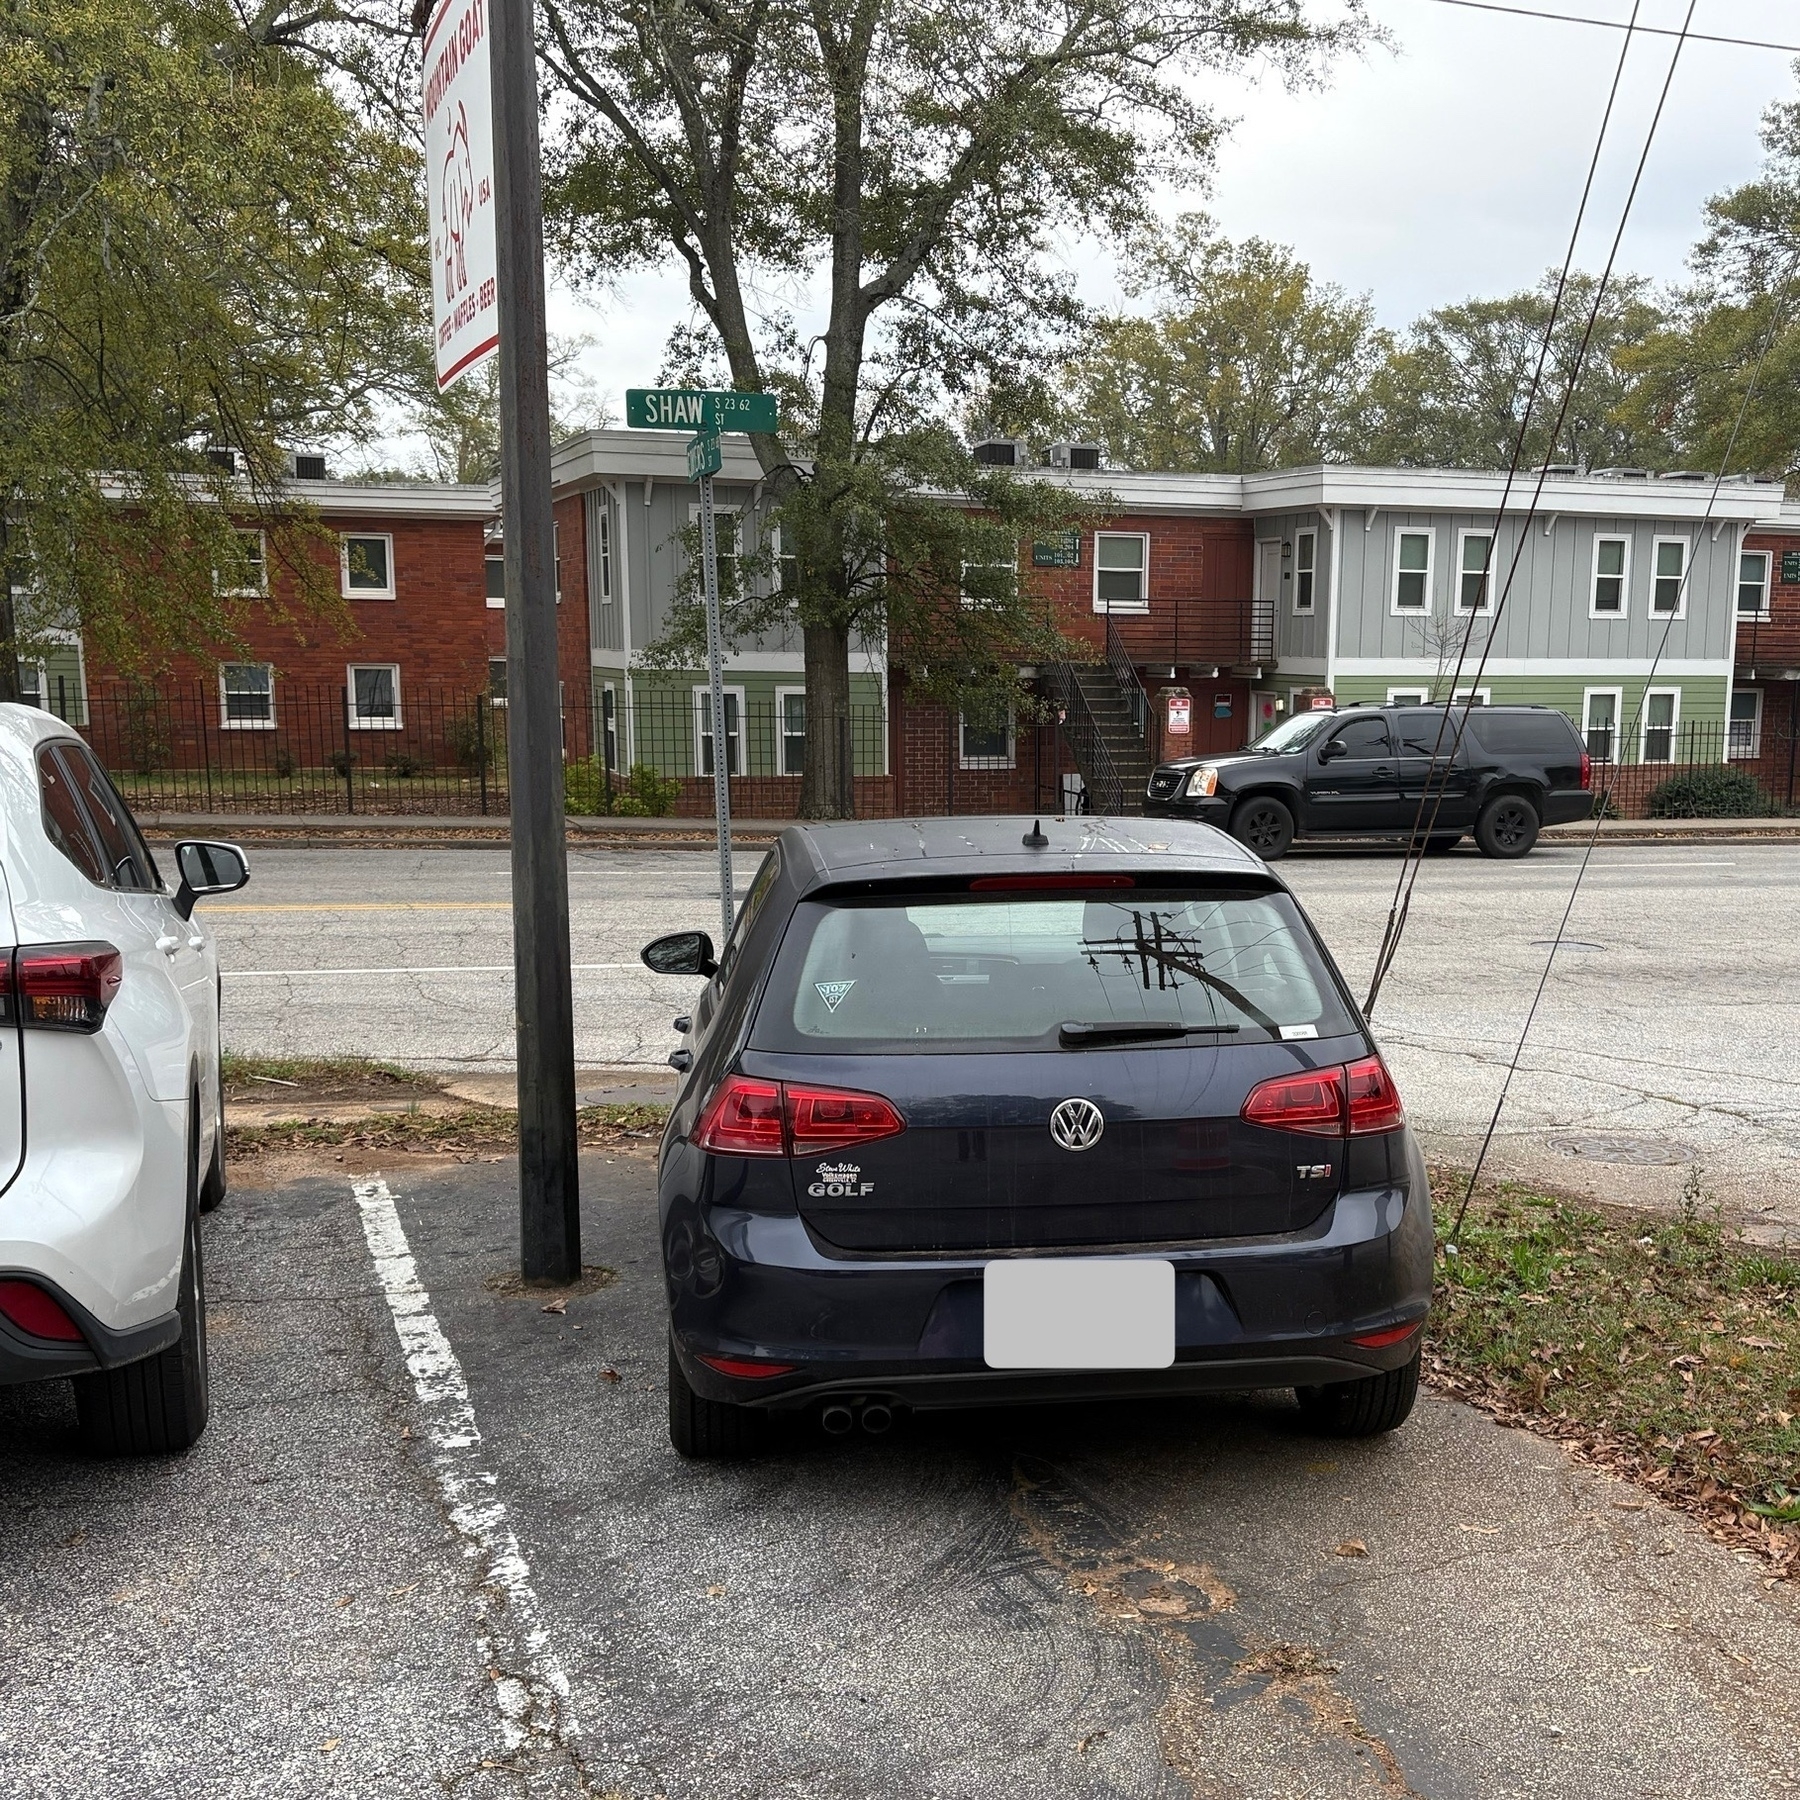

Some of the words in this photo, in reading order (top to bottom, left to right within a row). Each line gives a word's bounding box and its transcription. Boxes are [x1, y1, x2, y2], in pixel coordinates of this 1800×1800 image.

[425, 30, 459, 130] MOUNTAIN
[459, 0, 484, 65] GOAT
[478, 175, 491, 207] USA
[453, 292, 475, 334] WAFFLES
[479, 276, 496, 312] BEER
[645, 394, 703, 424] SHAW
[714, 397, 721, 409] S
[725, 398, 736, 410] 23
[739, 399, 750, 411] 62
[714, 413, 725, 425] ST
[807, 1182, 875, 1197] GOLF
